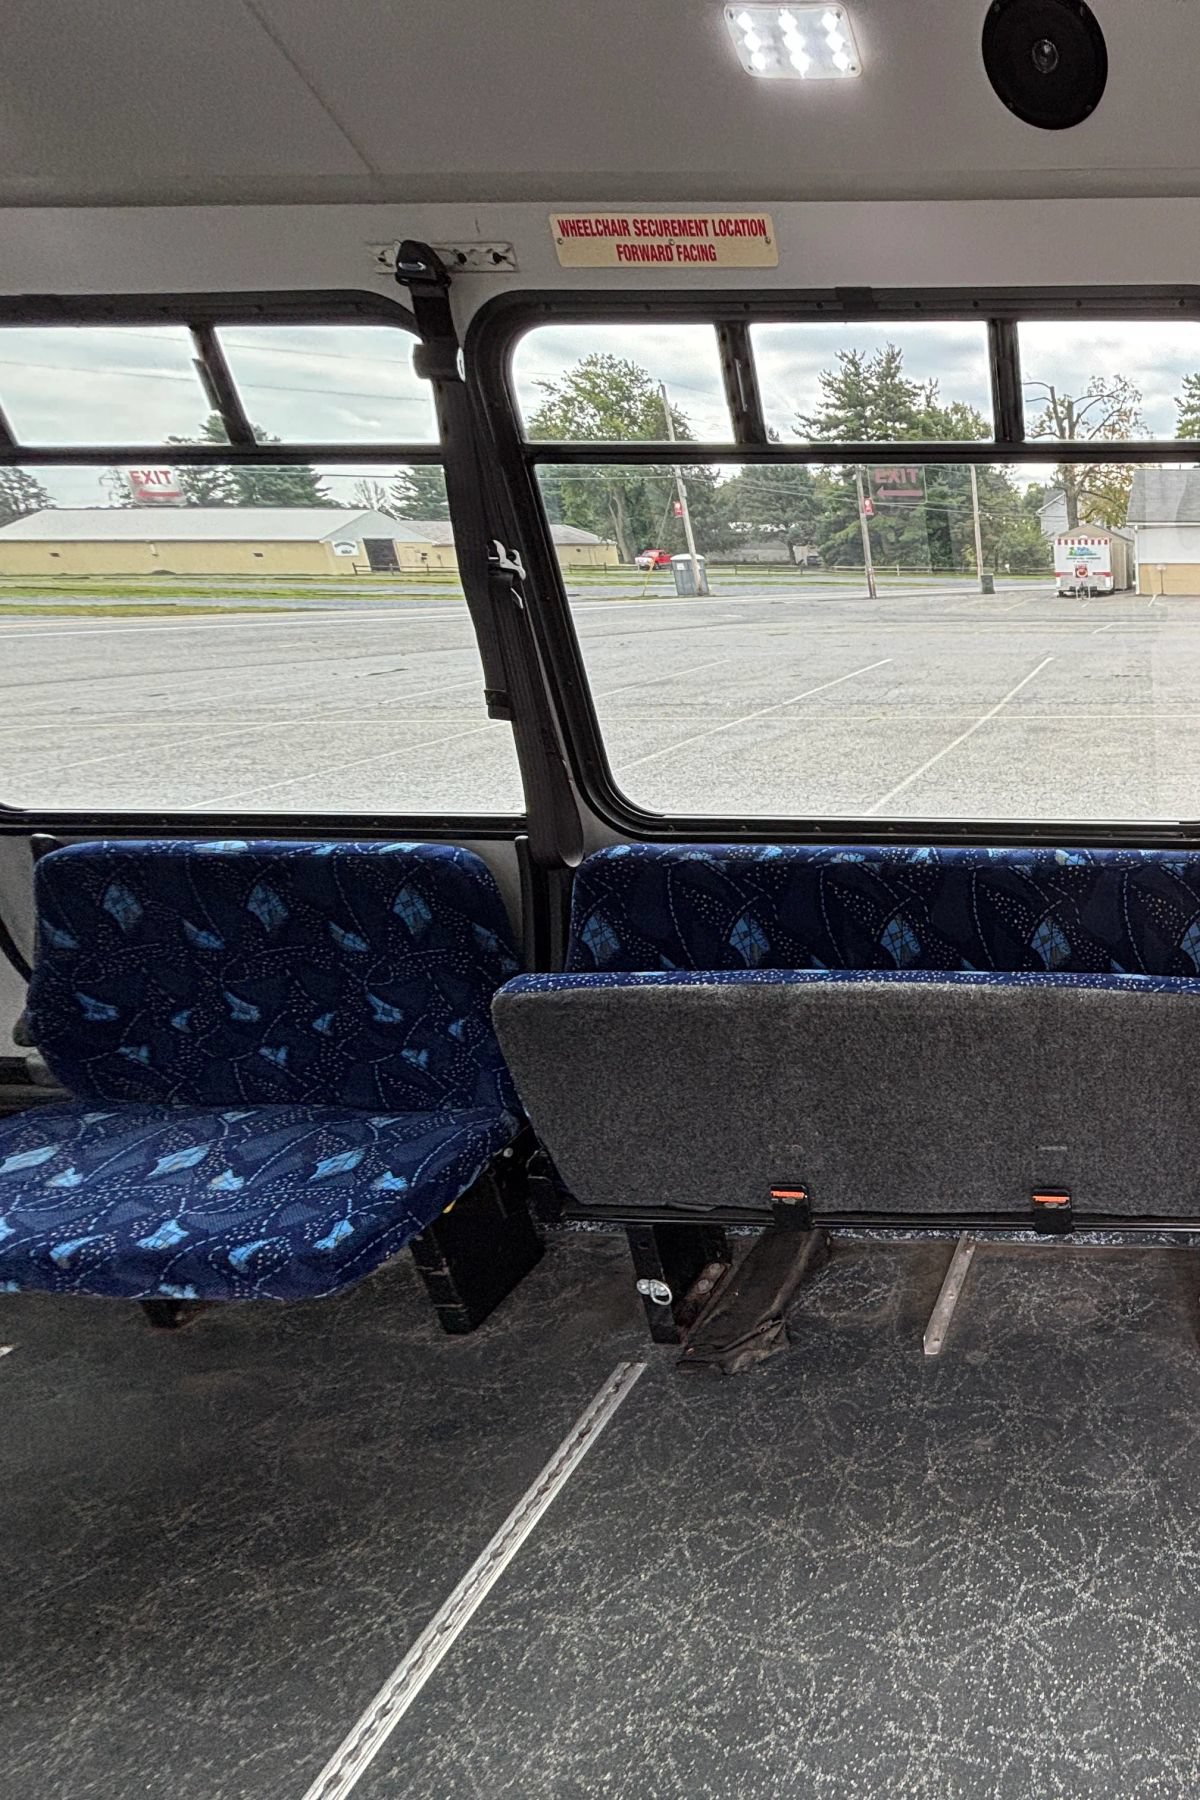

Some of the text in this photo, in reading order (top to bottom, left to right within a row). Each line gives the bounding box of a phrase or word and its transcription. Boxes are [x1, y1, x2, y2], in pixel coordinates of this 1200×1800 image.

[557, 219, 767, 237] WHEELCHAIR SECUREMENT LOCATION
[616, 244, 718, 262] FORWARD FACING
[128, 470, 172, 485] EXIT
[875, 468, 918, 483] EXIT
